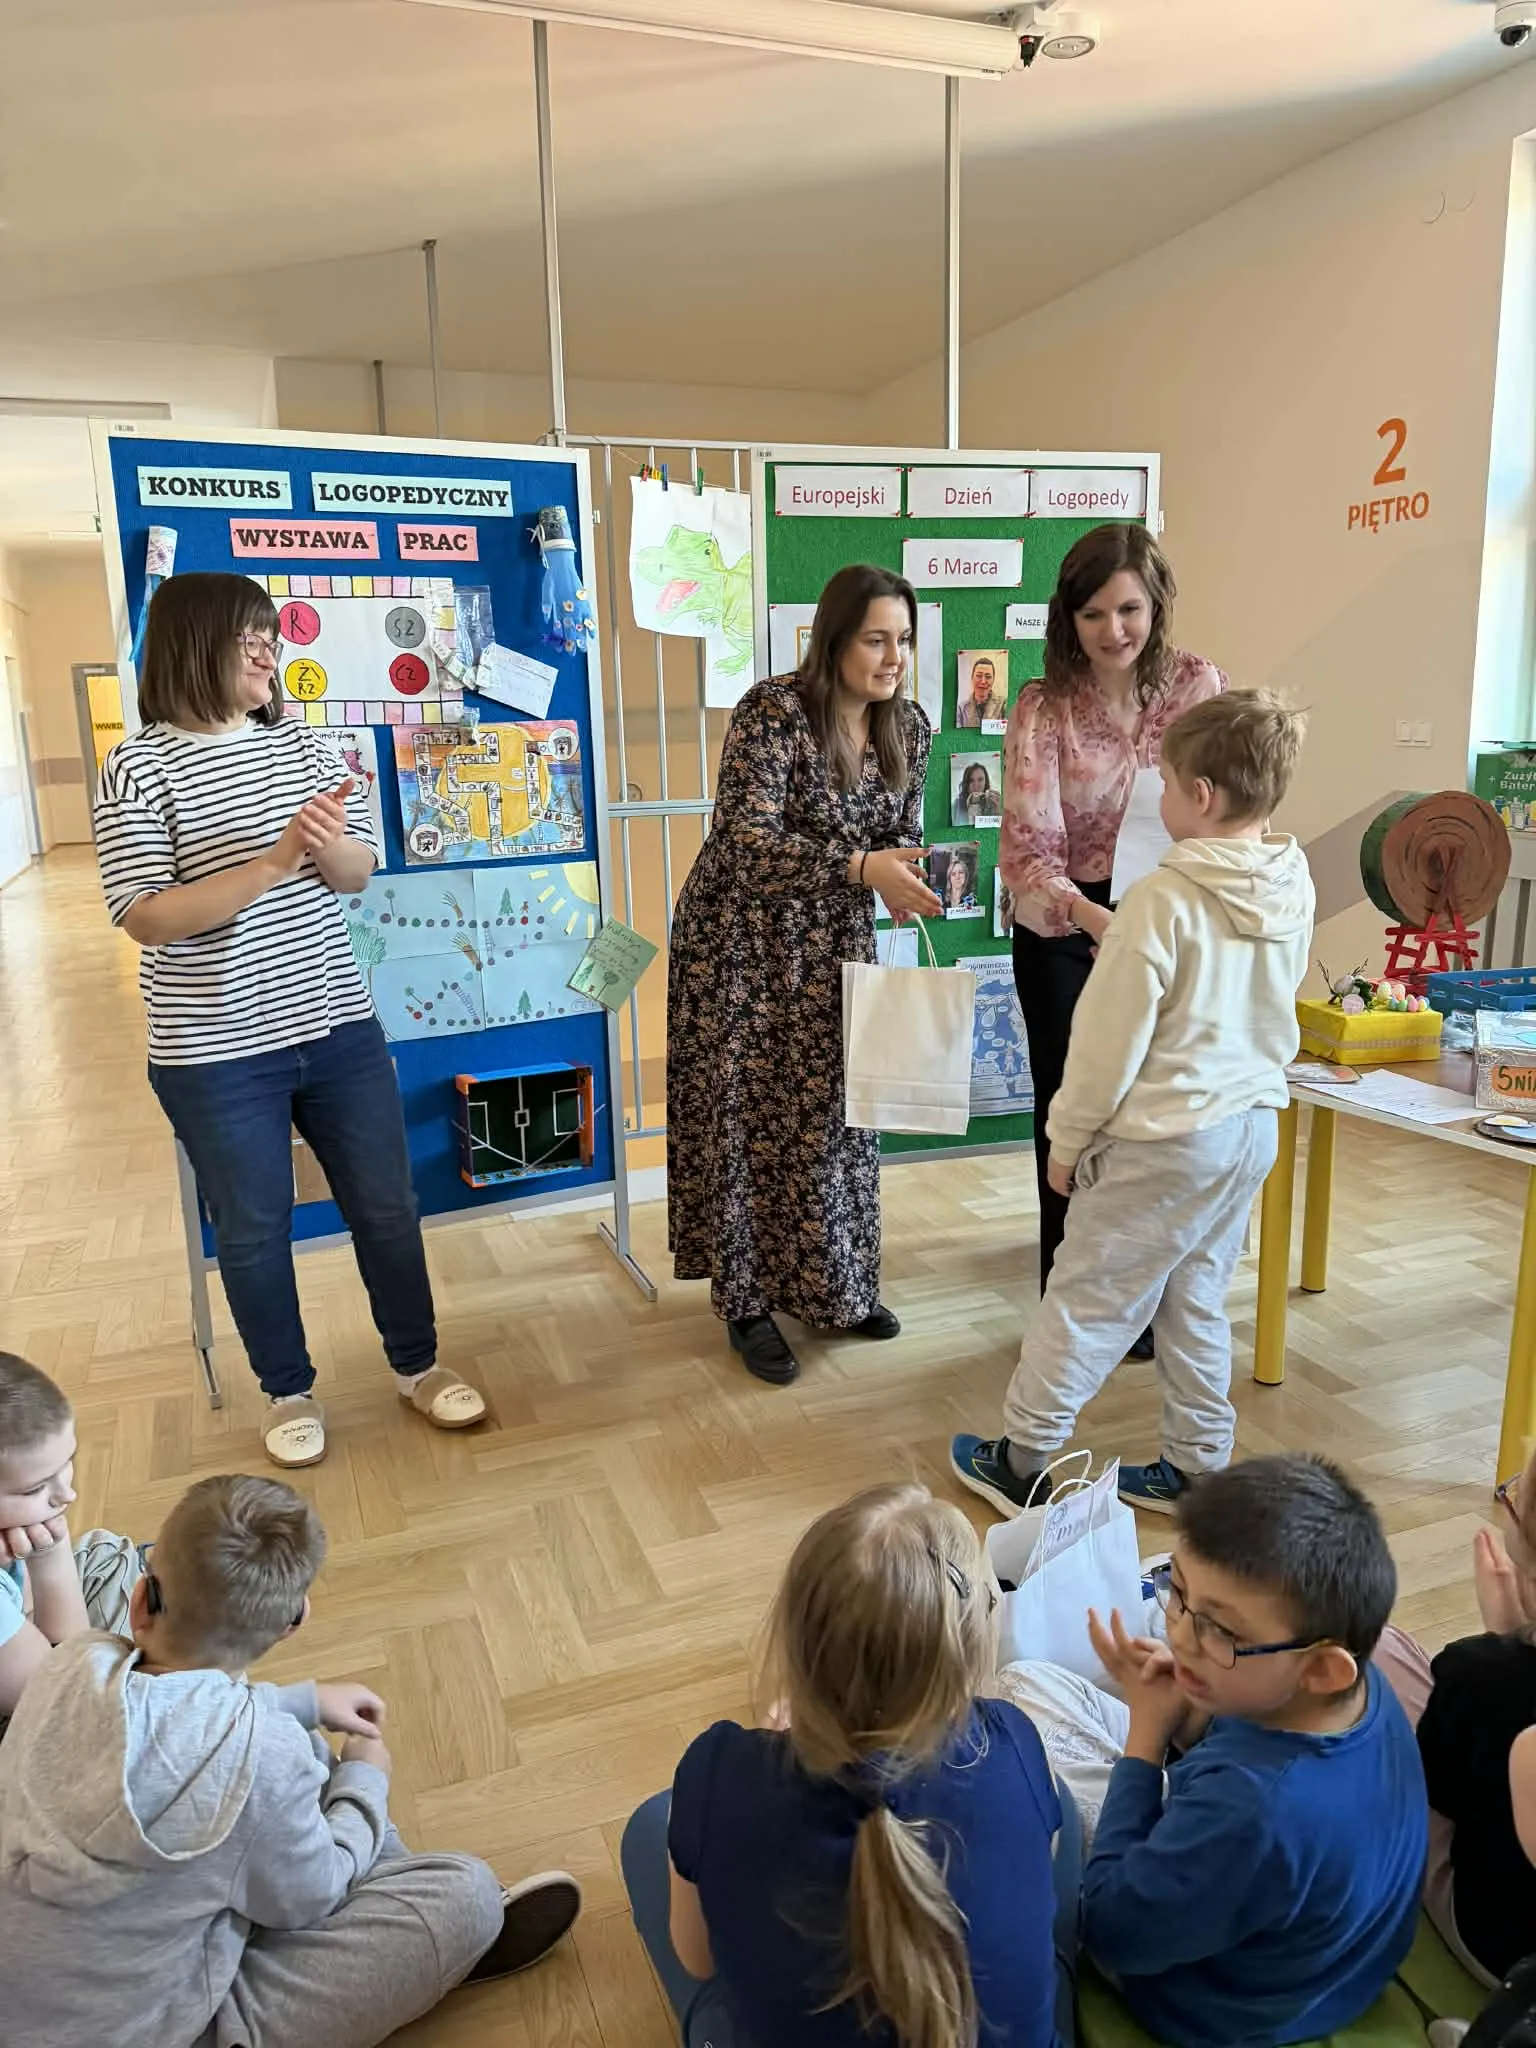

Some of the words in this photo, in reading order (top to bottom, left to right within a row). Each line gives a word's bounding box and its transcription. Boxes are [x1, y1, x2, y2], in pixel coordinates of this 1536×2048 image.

[1373, 417, 1408, 486] 2
[147, 475, 281, 499] KONKURS
[317, 482, 509, 508] LOGOPEDYCZNY
[791, 485, 886, 509] Europejski
[944, 485, 993, 506] Dzień
[1047, 488, 1130, 510] Logopedy
[1347, 490, 1430, 534] PIĘTRO
[235, 528, 370, 550] WYSTAWA
[403, 531, 469, 551] PRAC
[927, 557, 939, 576] 6
[944, 557, 999, 576] Marca
[290, 607, 307, 639] R
